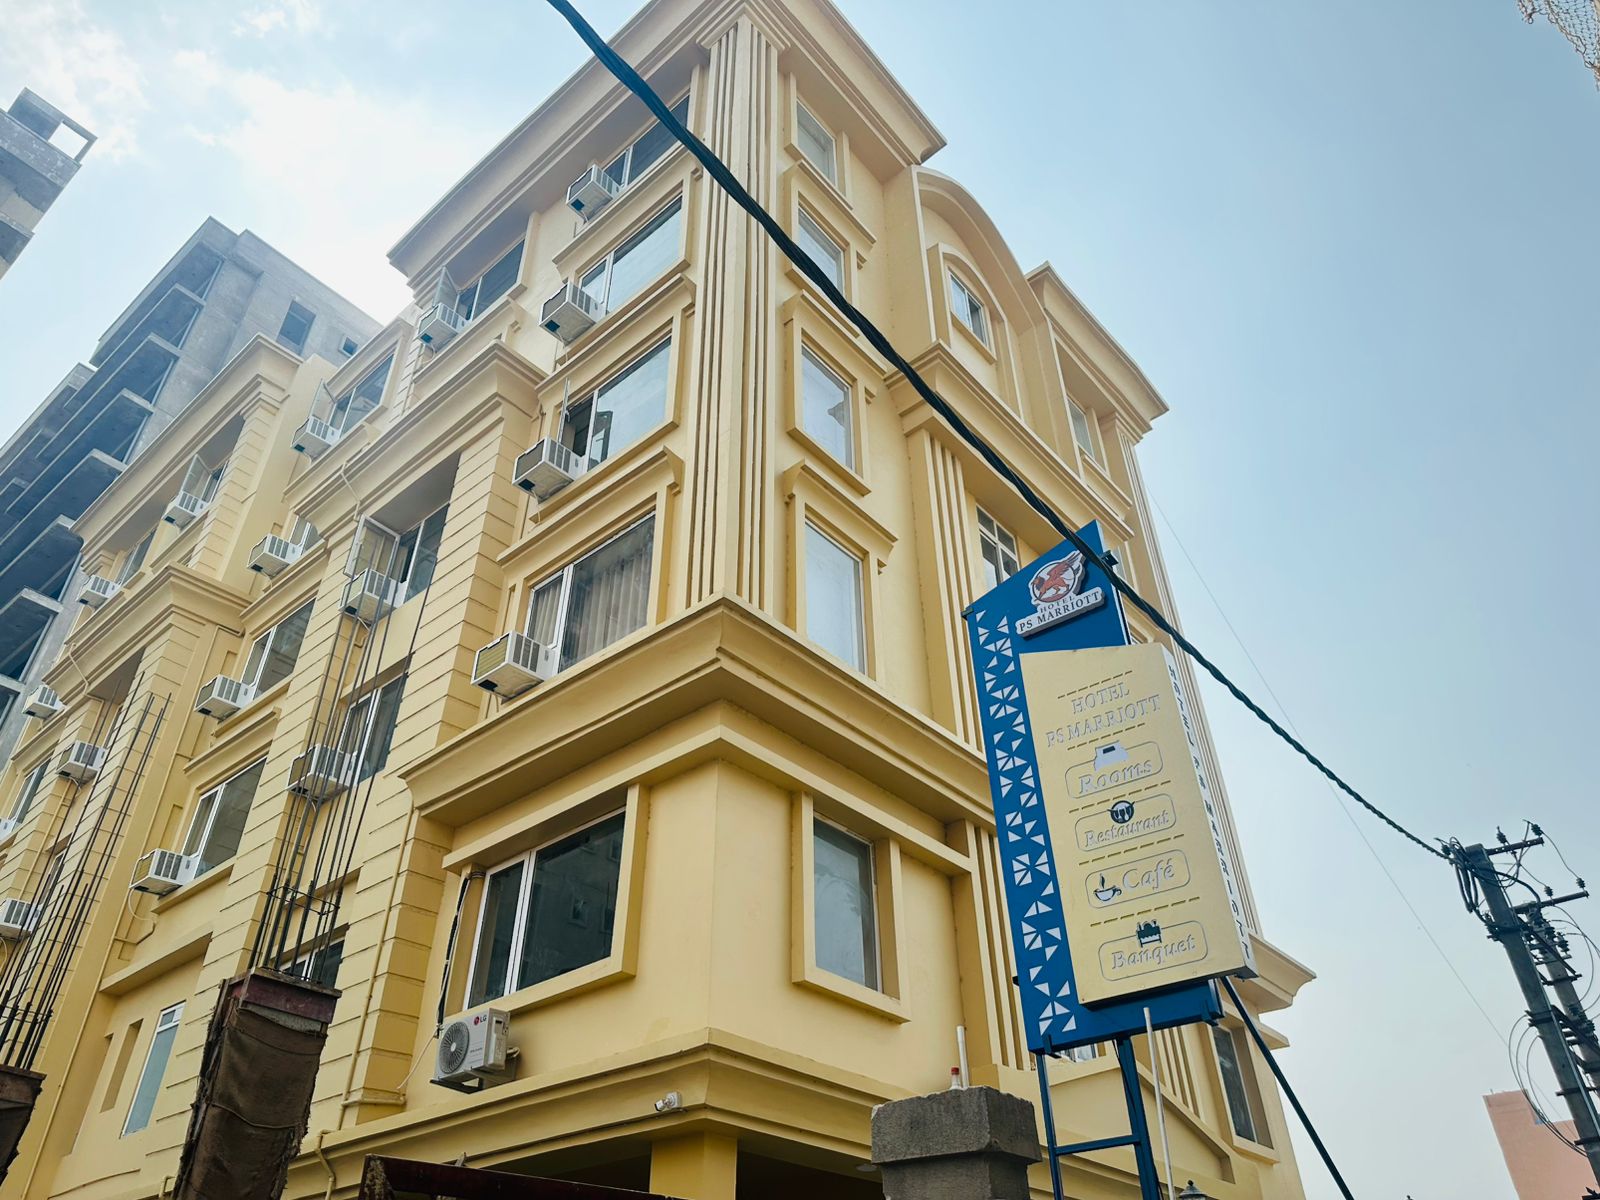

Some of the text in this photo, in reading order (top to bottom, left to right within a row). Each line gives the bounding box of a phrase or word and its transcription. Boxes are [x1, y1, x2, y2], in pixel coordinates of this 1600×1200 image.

[1019, 590, 1100, 632] PS MARRIOTT
[1040, 595, 1076, 614] HOTEL
[1071, 681, 1131, 715] HOTEL
[1045, 693, 1161, 748] PS MARRIOTT
[1078, 759, 1152, 795] Rooms
[1084, 809, 1170, 848] Restaurant
[1122, 858, 1175, 892] Café
[1111, 933, 1196, 970] Banquet
[480, 1014, 487, 1023] LG
